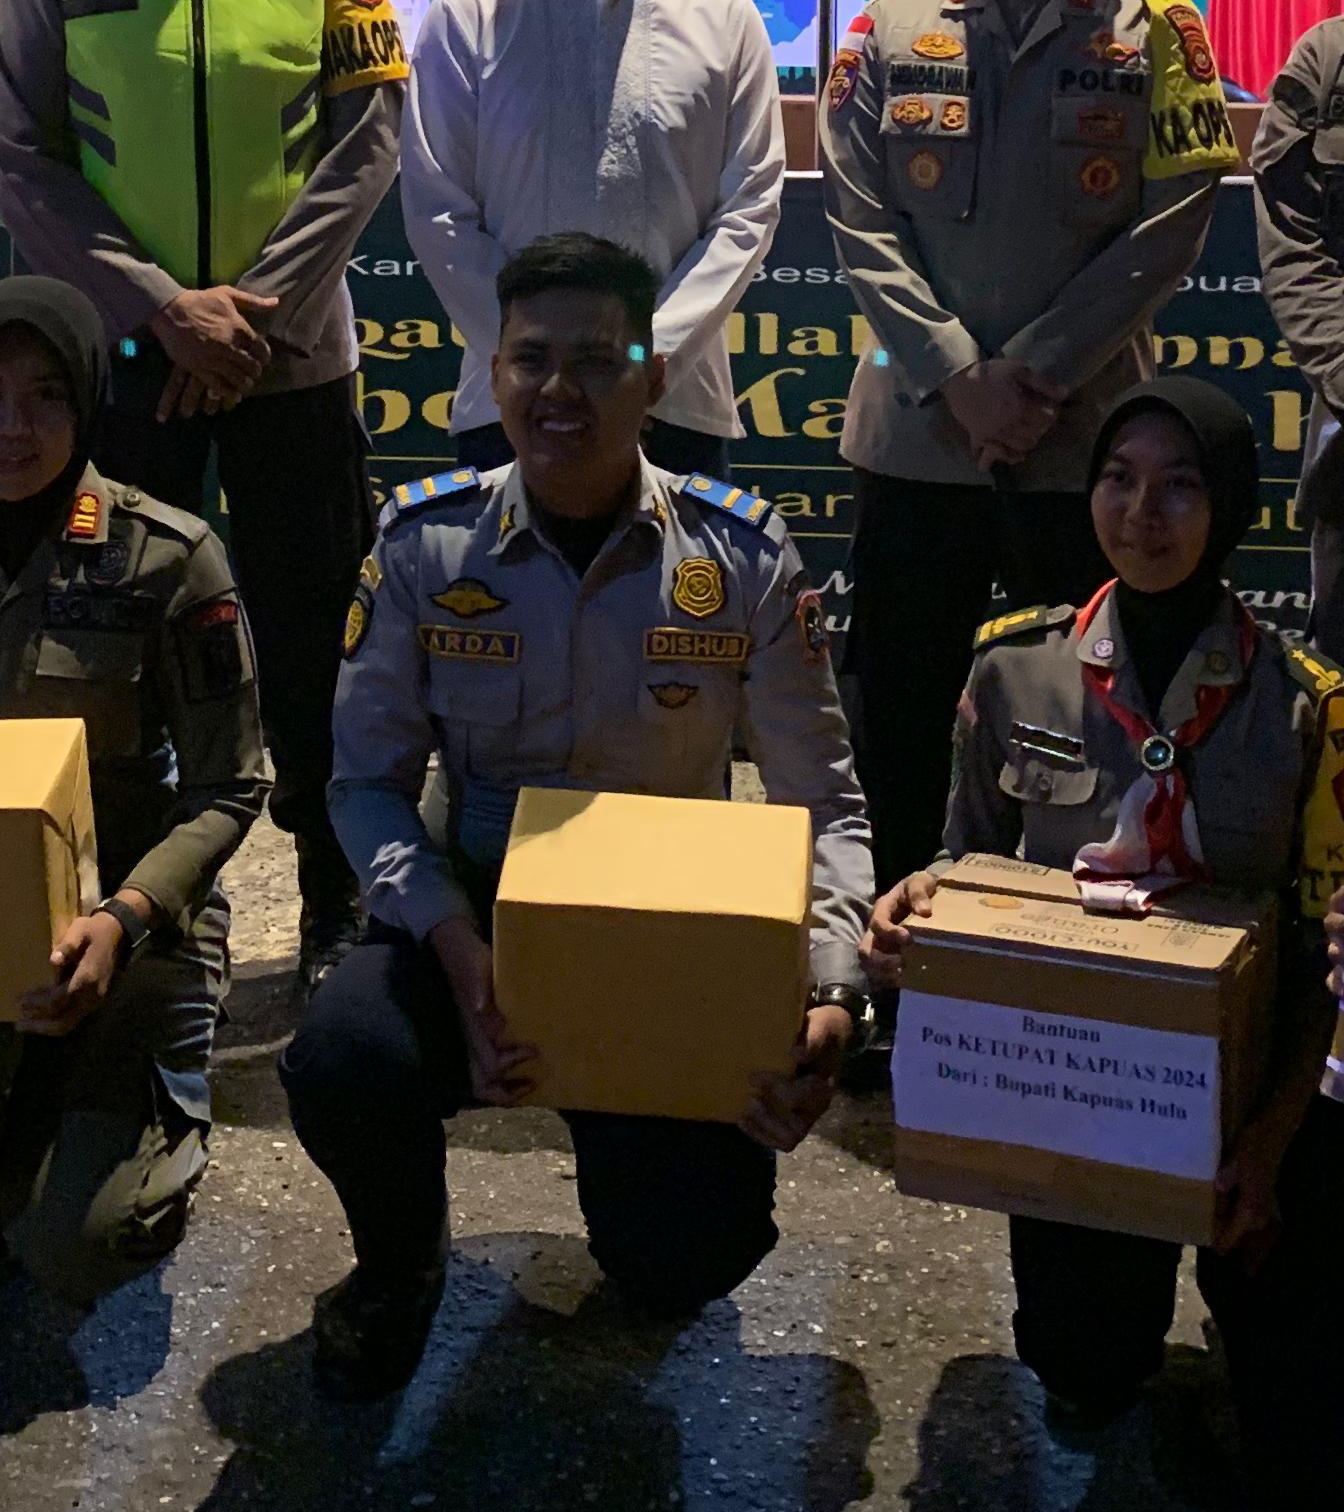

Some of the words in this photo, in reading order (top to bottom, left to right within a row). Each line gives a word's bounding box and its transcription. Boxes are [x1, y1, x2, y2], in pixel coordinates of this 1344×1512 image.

[1058, 68, 1146, 97] POLRI
[1022, 1015, 1102, 1044] Bantuan
[922, 1026, 952, 1048] Pos
[957, 1032, 1057, 1066] KETUPAT
[1064, 1051, 1157, 1083] KAPUAS
[1161, 1066, 1208, 1090] 2024
[937, 1062, 977, 1085] Dari
[995, 1073, 1057, 1099] Bupati
[1062, 1084, 1134, 1113] Kapuas
[1139, 1096, 1188, 1121] Hulu
